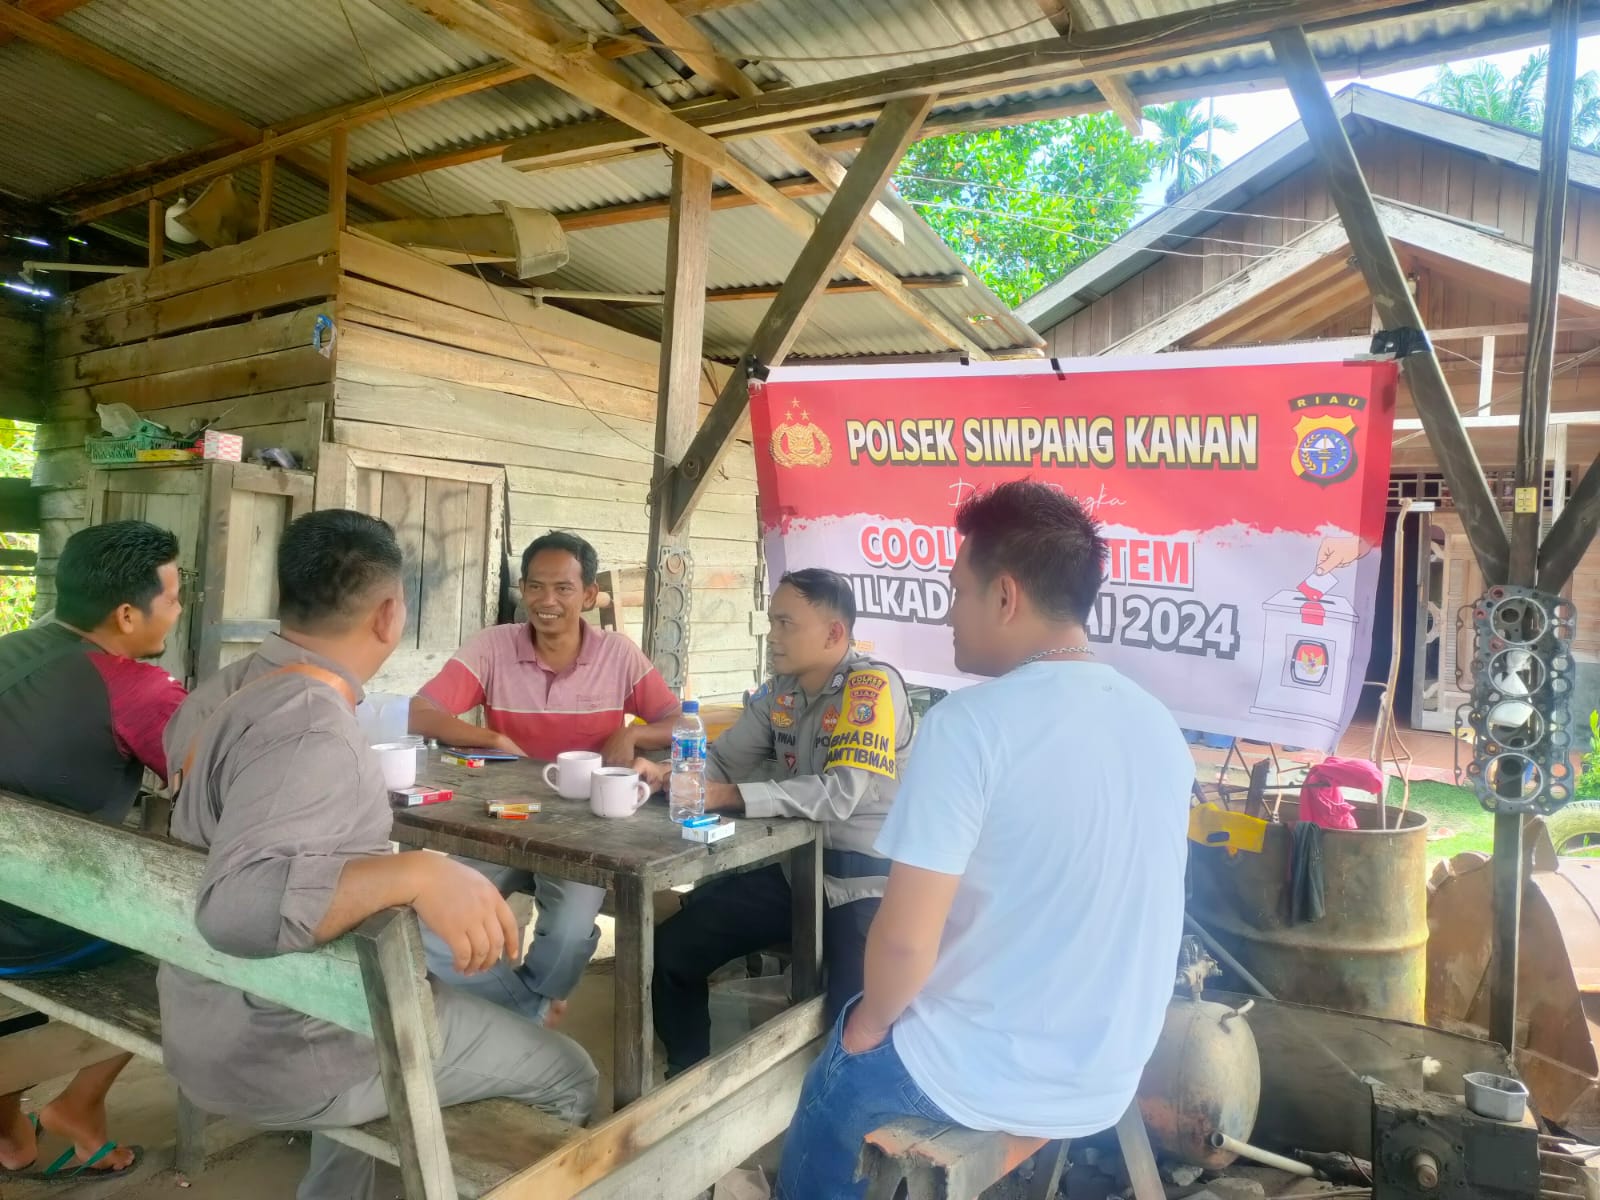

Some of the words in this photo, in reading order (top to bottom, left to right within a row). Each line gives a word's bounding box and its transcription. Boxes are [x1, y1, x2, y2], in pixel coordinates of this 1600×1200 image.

[1297, 395, 1358, 407] RIAU
[846, 418, 959, 465] POLSEK
[963, 415, 1115, 467] SIMPANG
[1125, 414, 1258, 468] KANAN
[842, 574, 955, 623] ILKAD
[1122, 595, 1239, 658] 2024
